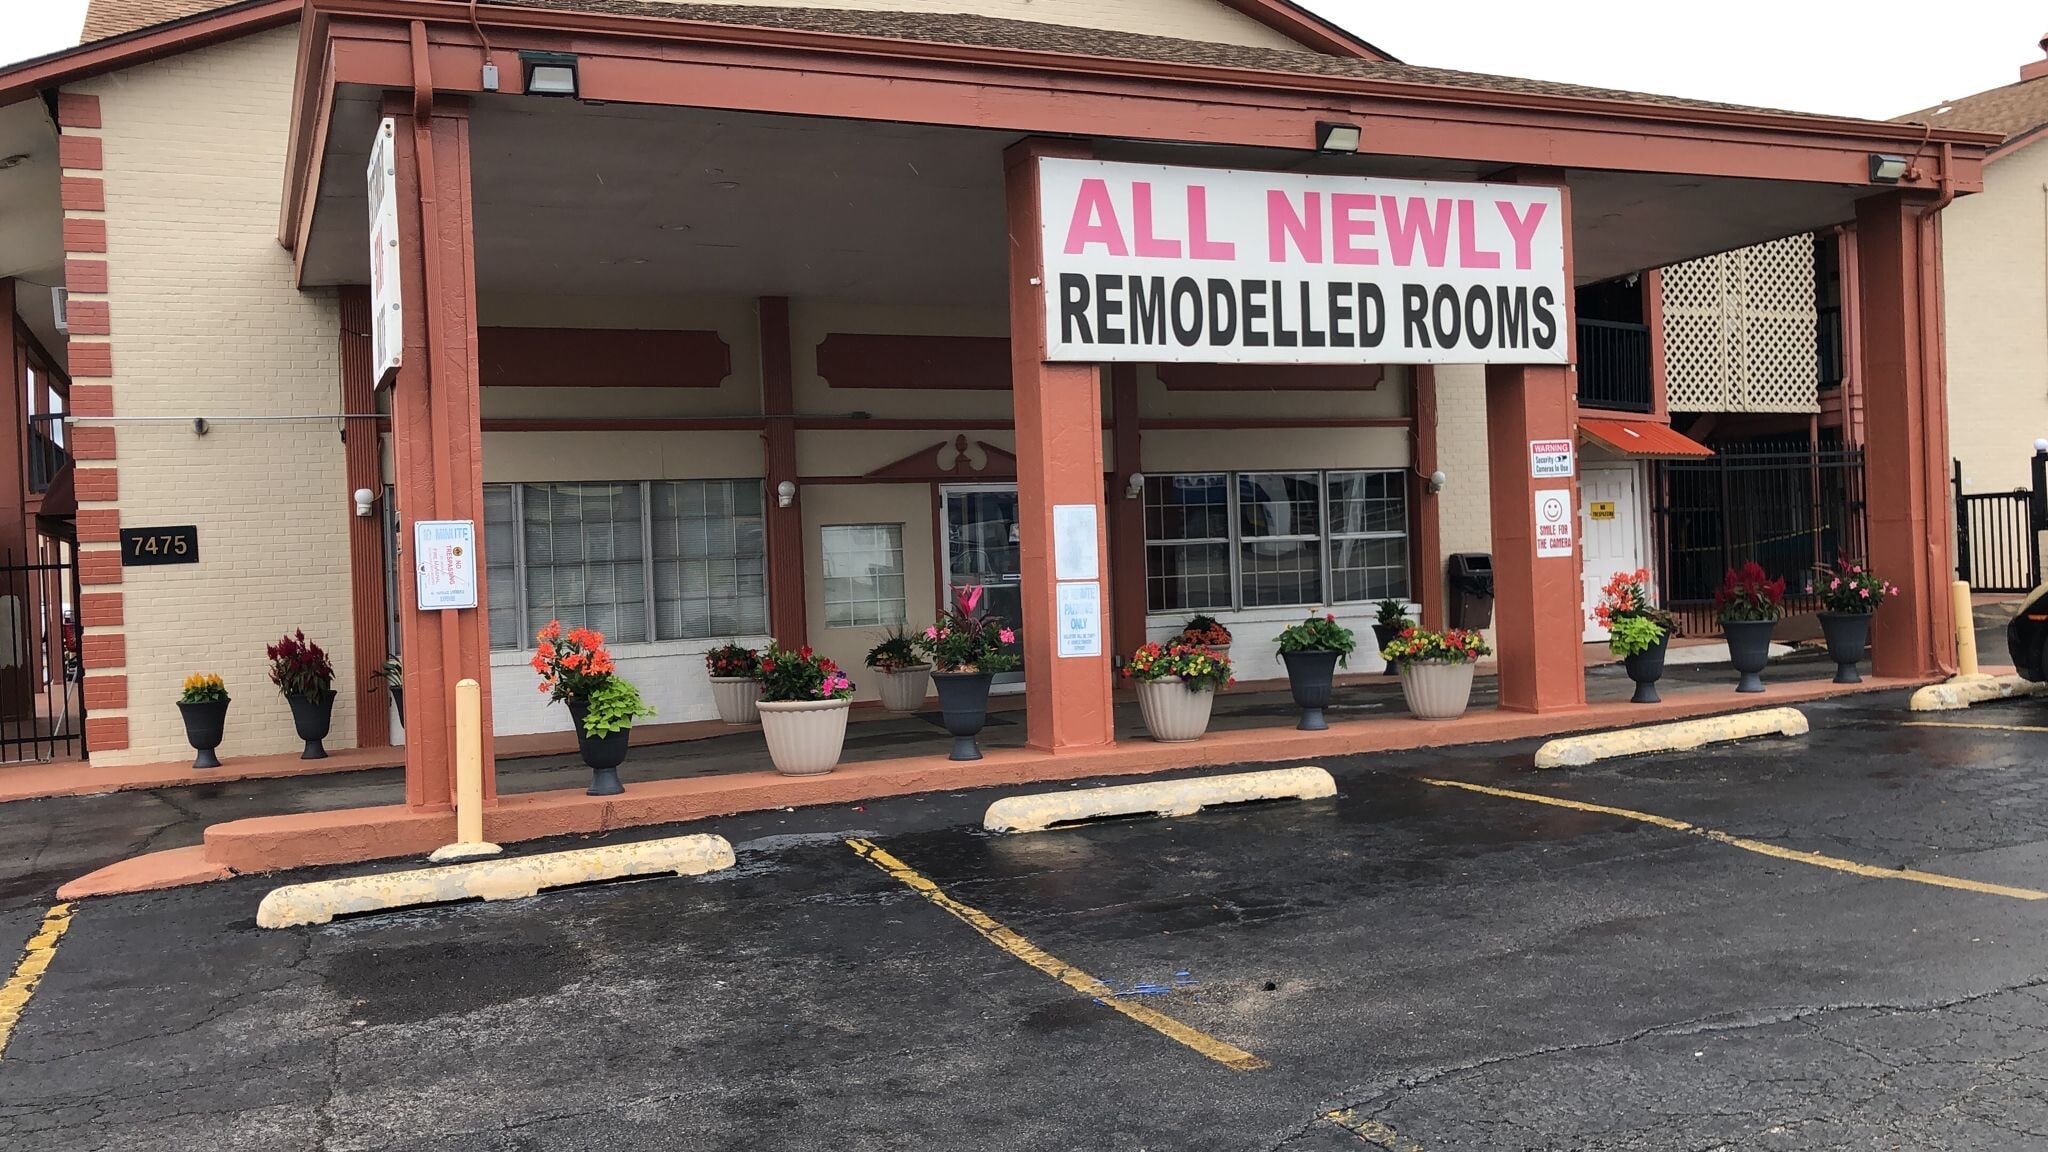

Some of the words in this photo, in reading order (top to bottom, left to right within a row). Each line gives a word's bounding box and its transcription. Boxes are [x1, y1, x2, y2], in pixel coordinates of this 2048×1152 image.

[1064, 178, 1236, 261] ALL
[1266, 189, 1548, 270] NEWLY
[1059, 272, 1386, 347] REMODELLED
[1402, 283, 1557, 350] ROOMS
[1534, 443, 1569, 453] WARNING
[1535, 456, 1554, 465] Security
[1536, 464, 1554, 473] Cameras
[1560, 463, 1569, 472] Use
[1539, 524, 1556, 536] SMILE
[1558, 524, 1568, 536] FOR
[131, 535, 188, 556] 7475
[1537, 538, 1547, 550] THE
[1549, 537, 1571, 549] CAMERA
